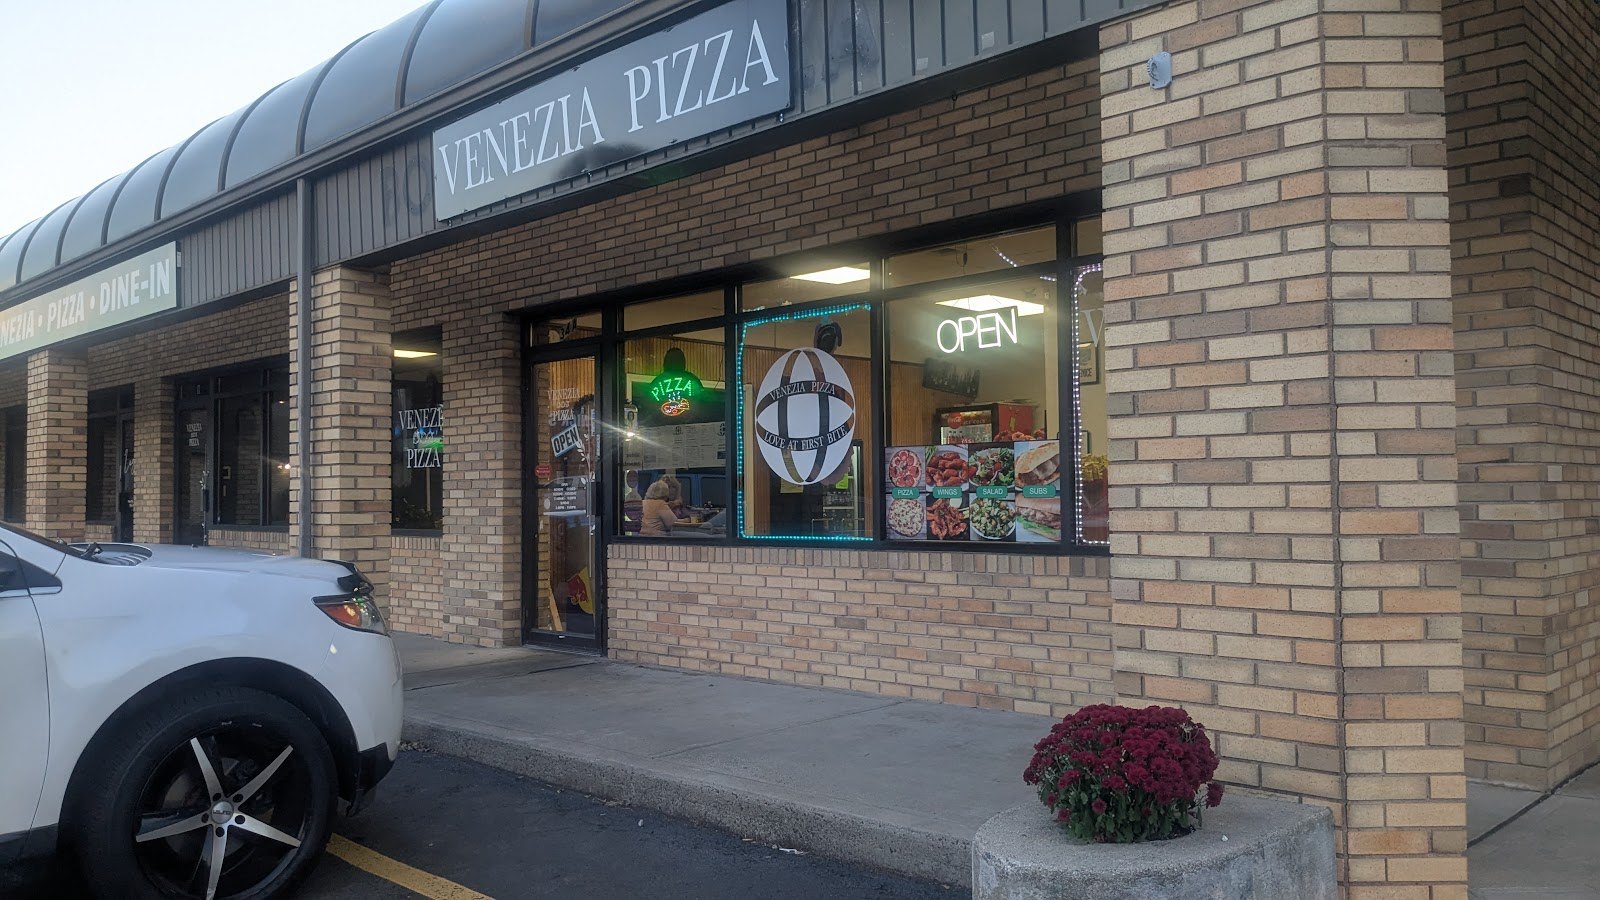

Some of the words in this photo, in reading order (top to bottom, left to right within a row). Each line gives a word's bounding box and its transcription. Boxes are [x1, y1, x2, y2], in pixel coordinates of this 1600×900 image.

[438, 86, 605, 196] VENEZIA
[624, 19, 779, 133] PIZZA
[0, 310, 35, 347] NEZIA
[47, 291, 85, 332] PIZZA
[100, 258, 170, 316] DINE-IN
[936, 308, 1018, 354] OPEN
[651, 377, 692, 401] PIZZA
[769, 382, 806, 400] VENEZIA
[811, 381, 836, 395] PIZZA
[552, 409, 574, 421] PIZZA
[553, 426, 579, 454] OPEN
[764, 431, 785, 449] LOVE
[787, 440, 799, 450] AT
[801, 436, 824, 450] FIRST
[826, 425, 848, 444] BITE
[407, 448, 441, 469] PIZZA
[982, 488, 1004, 496] SALAD
[1029, 487, 1048, 495] SUBS
